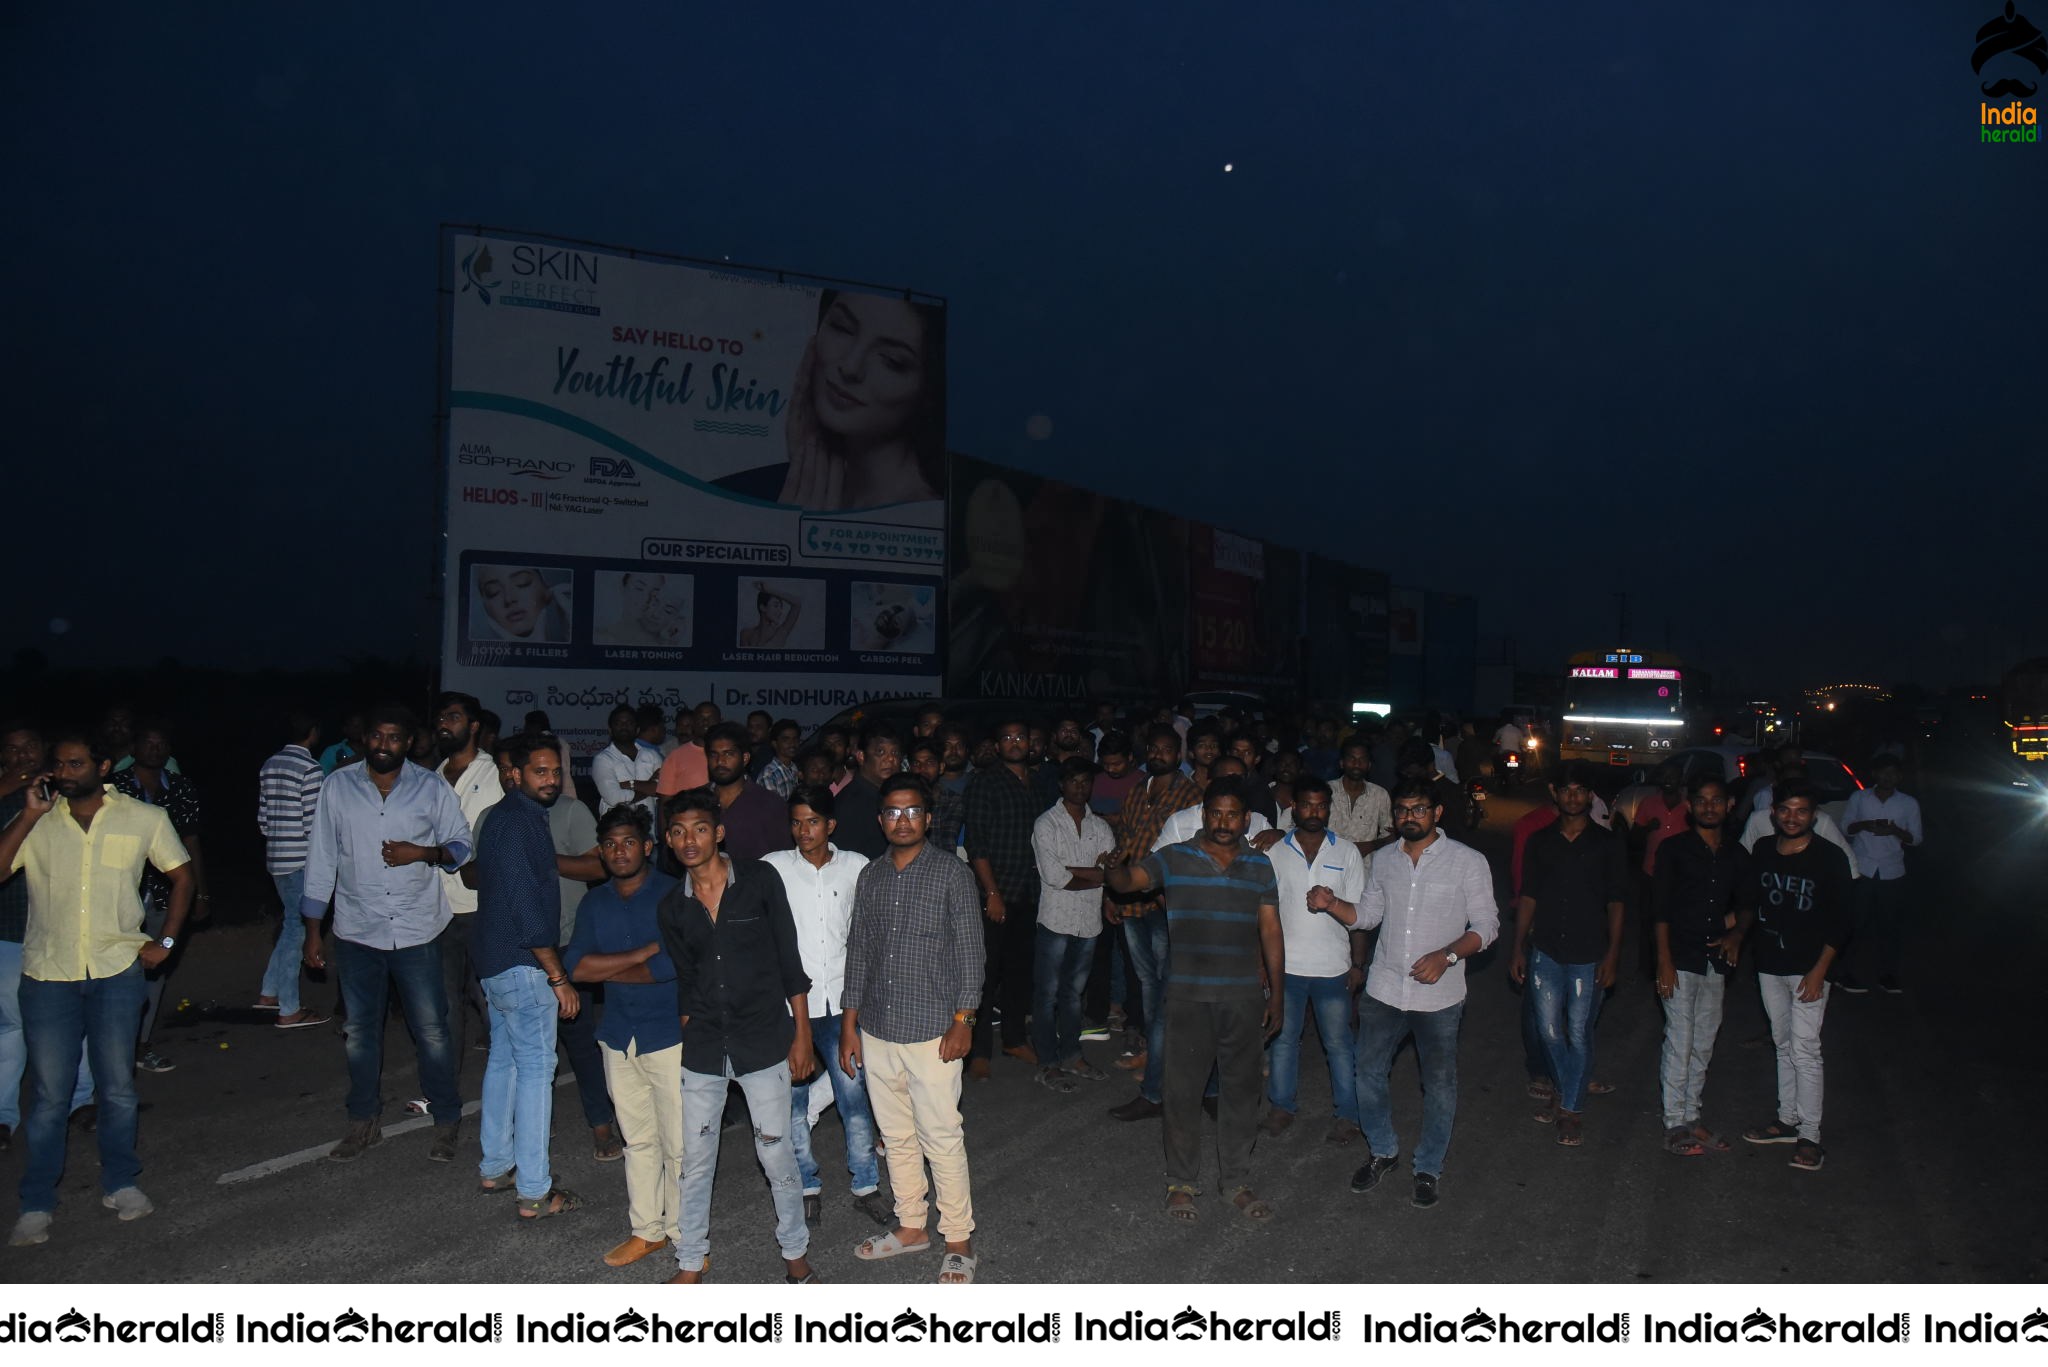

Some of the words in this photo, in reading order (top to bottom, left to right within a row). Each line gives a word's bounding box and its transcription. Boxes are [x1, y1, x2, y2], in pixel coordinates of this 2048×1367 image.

[512, 245, 598, 284] SKIN
[511, 280, 597, 304] PERFECT
[612, 326, 649, 344] SAY
[653, 330, 713, 352] HELLO
[718, 338, 744, 355] TO
[553, 346, 694, 411] Youthful
[706, 363, 788, 417] Skin
[460, 443, 491, 454] ALMA
[458, 454, 573, 473] SOPRANO
[590, 456, 635, 478] FDA
[463, 486, 518, 505] HELIOS
[549, 492, 561, 501] 4G
[563, 493, 601, 504] Fractional
[564, 504, 582, 513] YAG
[583, 506, 604, 514] Laser
[830, 528, 853, 538] FOR
[856, 529, 938, 545] APPOINTMENT
[648, 542, 682, 557] OUR
[685, 544, 787, 562] SPECIALITIES
[526, 647, 569, 658] FILLERS
[605, 649, 639, 659] LASER
[640, 650, 684, 661] TONING
[722, 651, 752, 662] LASER
[756, 652, 782, 662] HAIR
[784, 653, 839, 664] REDUCTION
[859, 654, 899, 665] CARBON
[1572, 668, 1614, 677] KALLAM
[980, 670, 1088, 697] KANKATALA
[726, 689, 752, 705] Dr.
[756, 689, 857, 706] SINDHURA
[1761, 872, 1815, 896] OVER
